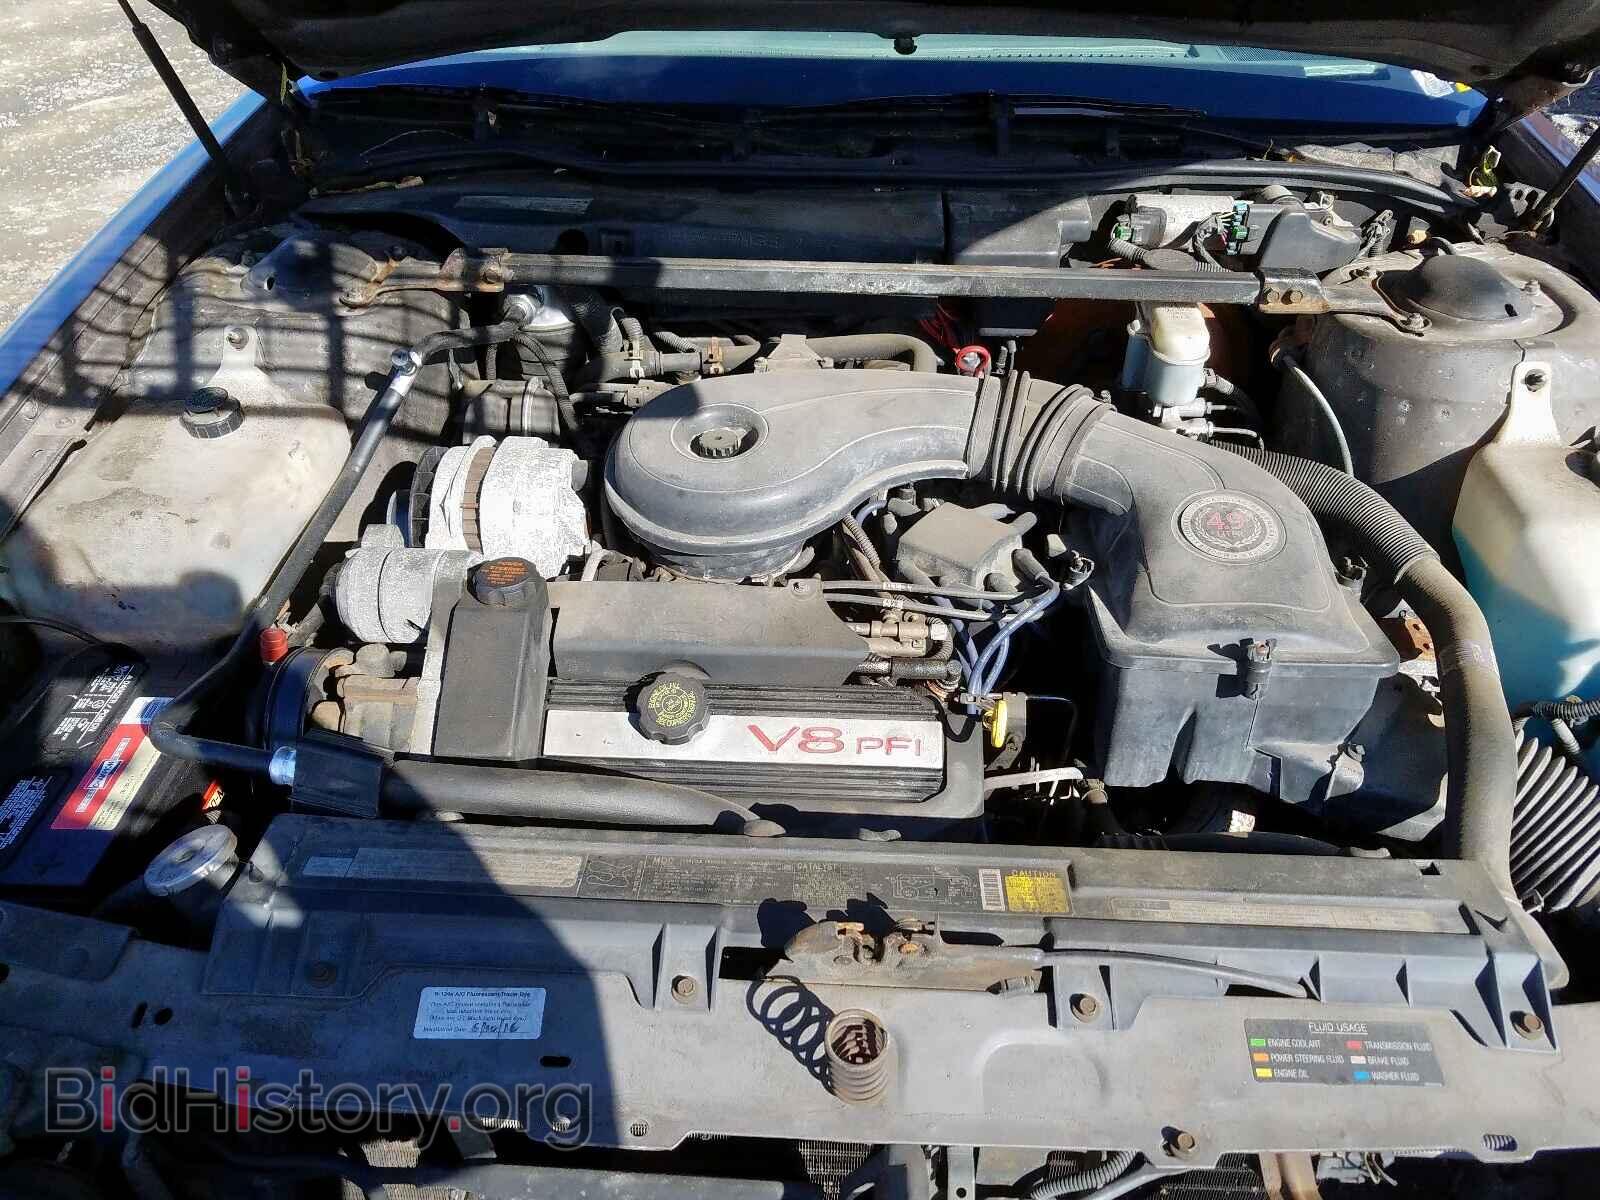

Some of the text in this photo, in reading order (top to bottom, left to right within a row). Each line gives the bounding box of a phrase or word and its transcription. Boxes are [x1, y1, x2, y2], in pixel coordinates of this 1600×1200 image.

[747, 724, 922, 757] V8 PFI
[1308, 1022, 1368, 1034] FLUID USAGE
[1267, 1039, 1320, 1049] ENGINE COOLANT
[1271, 1053, 1345, 1065] POWER STEERING FLUID
[1367, 1055, 1409, 1066] BRAKE FLUID
[1274, 1068, 1311, 1079] ENGINE OIL
[1371, 1071, 1420, 1082] WASHER FLUID
